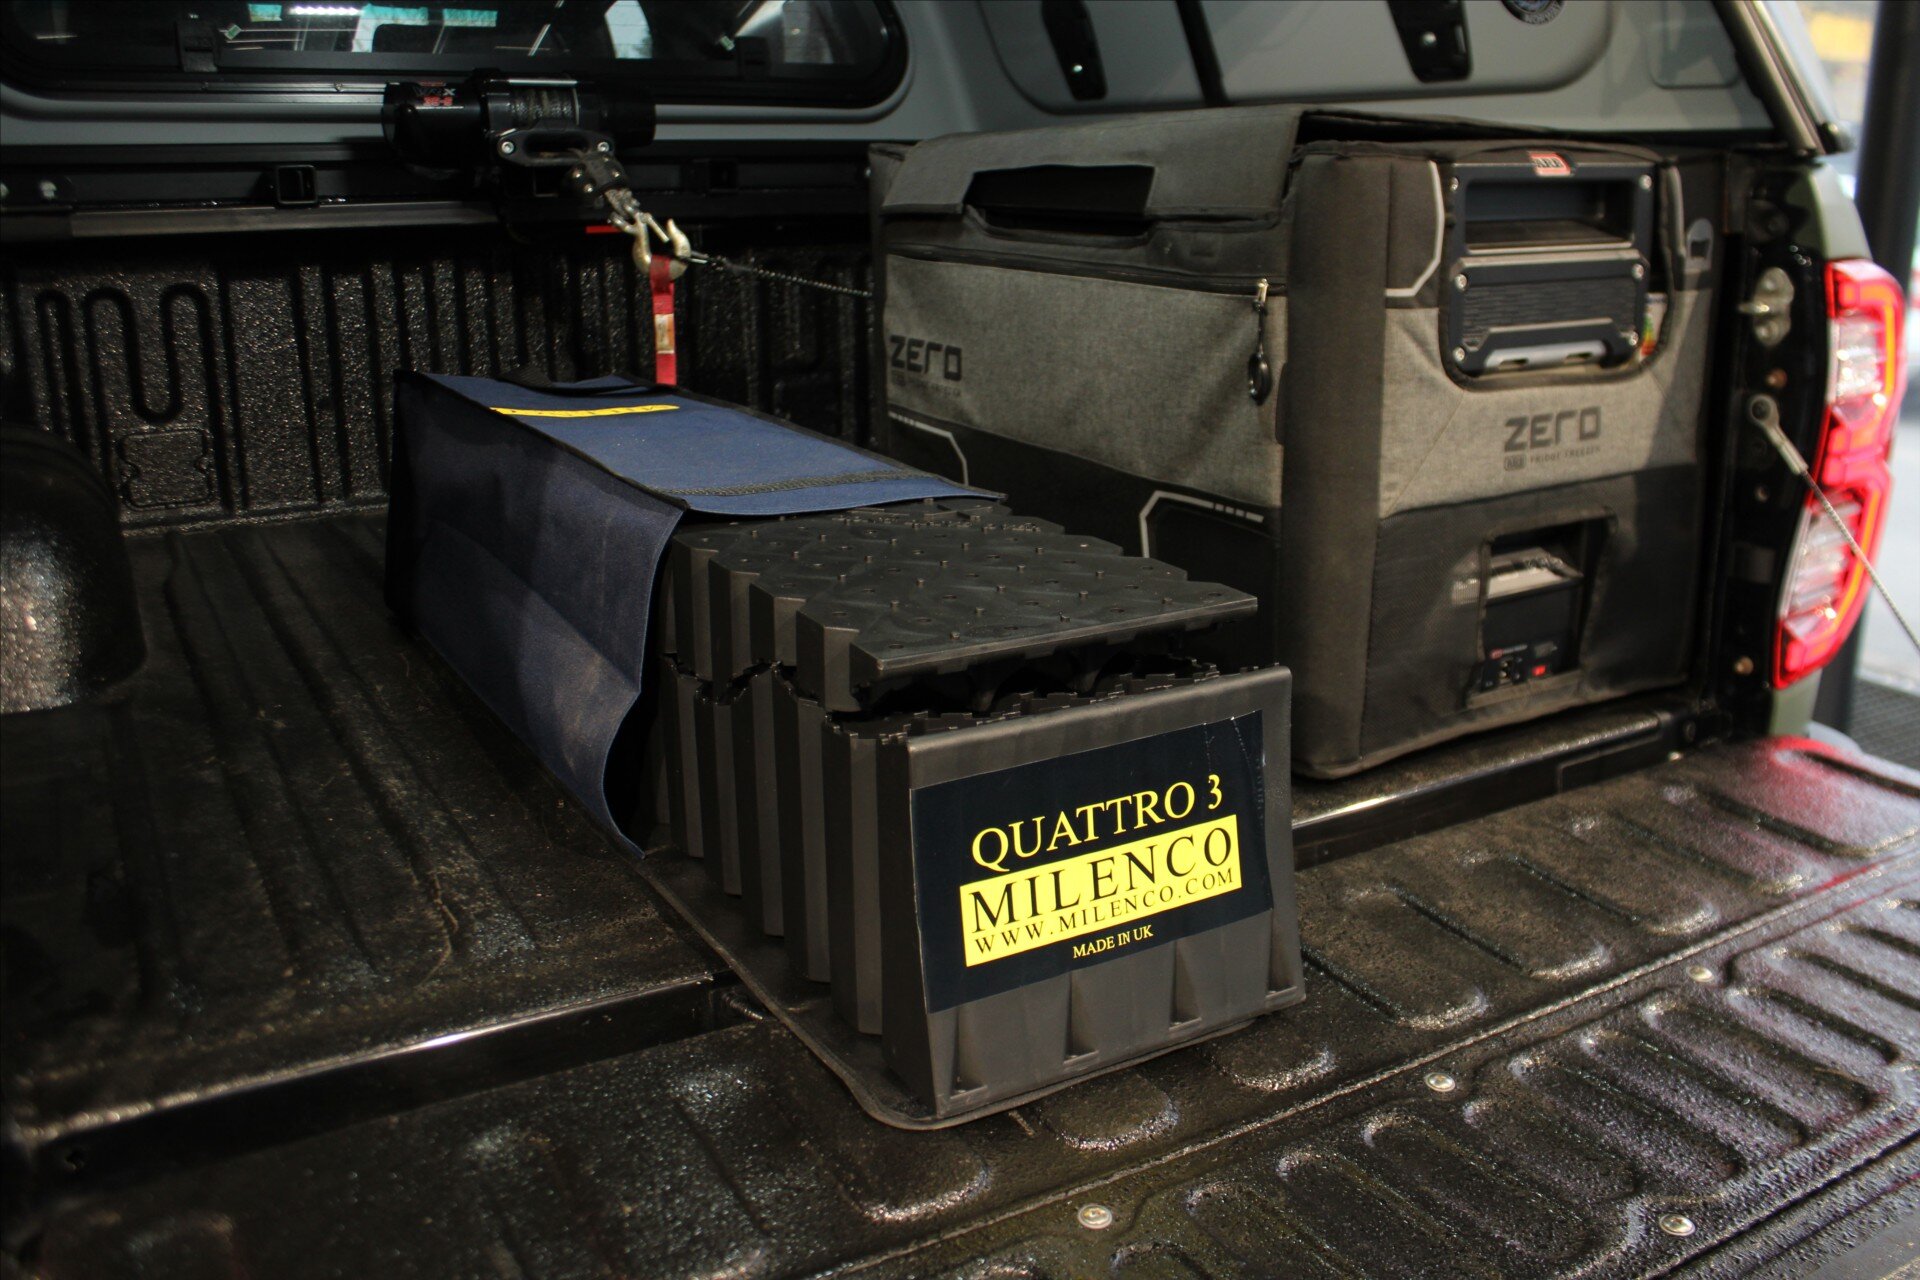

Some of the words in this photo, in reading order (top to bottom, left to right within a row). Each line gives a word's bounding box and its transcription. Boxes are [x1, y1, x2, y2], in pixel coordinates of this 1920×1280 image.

[971, 781, 1195, 873] QUATTRO
[1207, 774, 1223, 810] 3
[969, 827, 1232, 934] MILENCO
[974, 867, 1234, 955] WWW.MILENCO.COM
[1072, 935, 1115, 959] MADE
[1117, 930, 1131, 946] IN
[1132, 924, 1154, 941] UK
